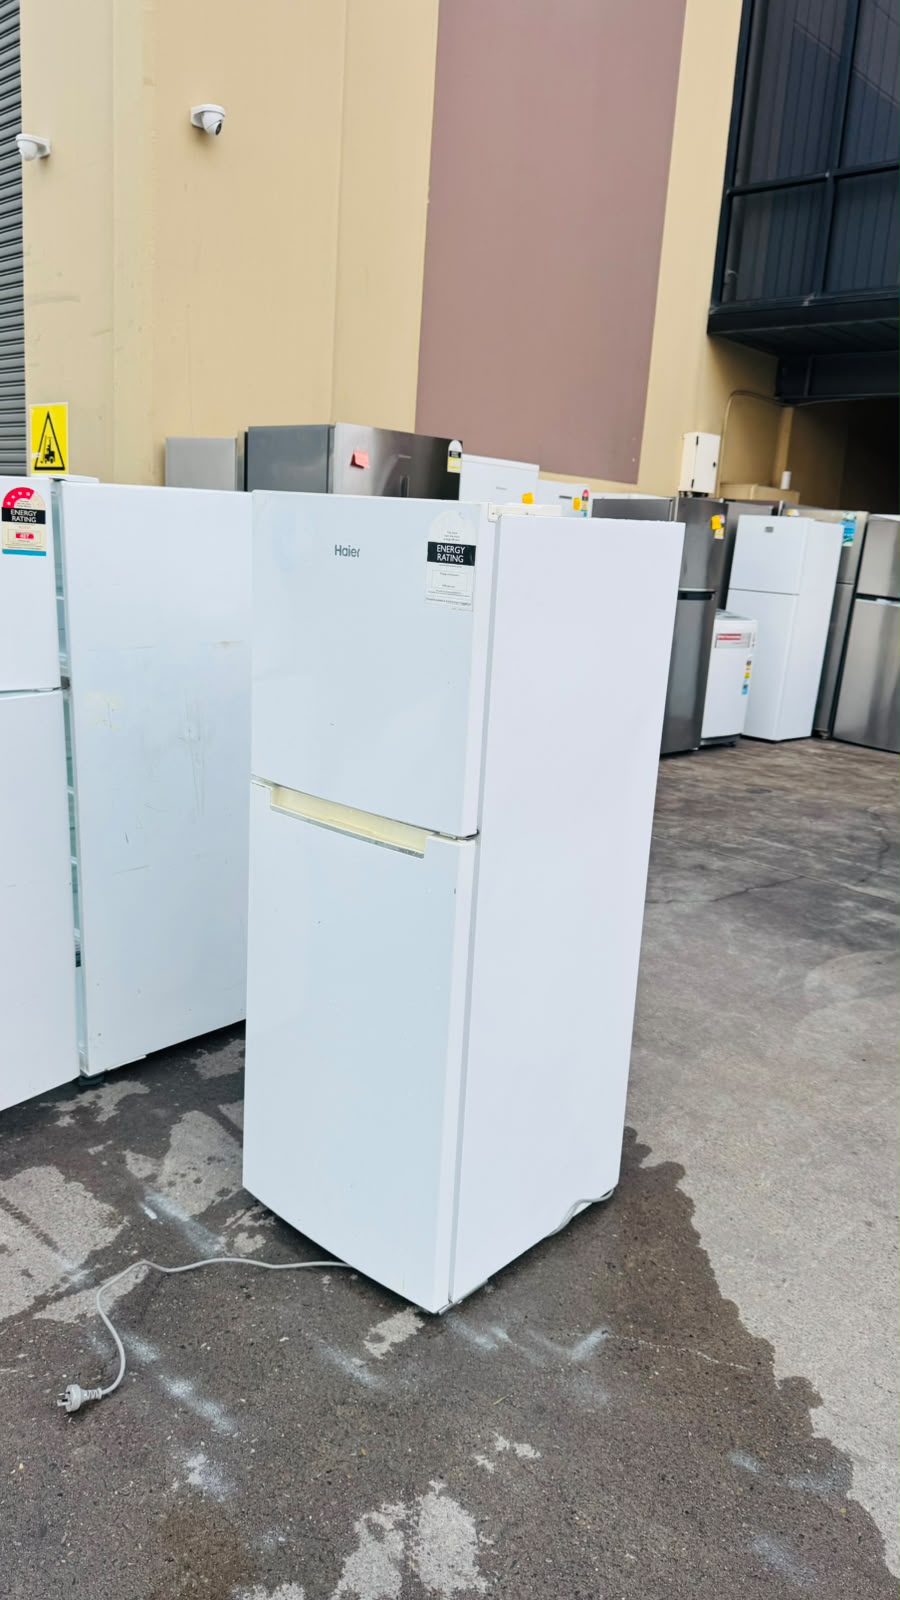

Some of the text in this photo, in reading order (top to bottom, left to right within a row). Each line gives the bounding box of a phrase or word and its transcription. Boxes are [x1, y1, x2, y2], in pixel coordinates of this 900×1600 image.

[10, 509, 37, 517] ENERGY
[11, 515, 37, 523] RATING
[334, 544, 360, 558] Haier
[436, 544, 466, 555] ENERGY
[436, 553, 464, 563] RATING
